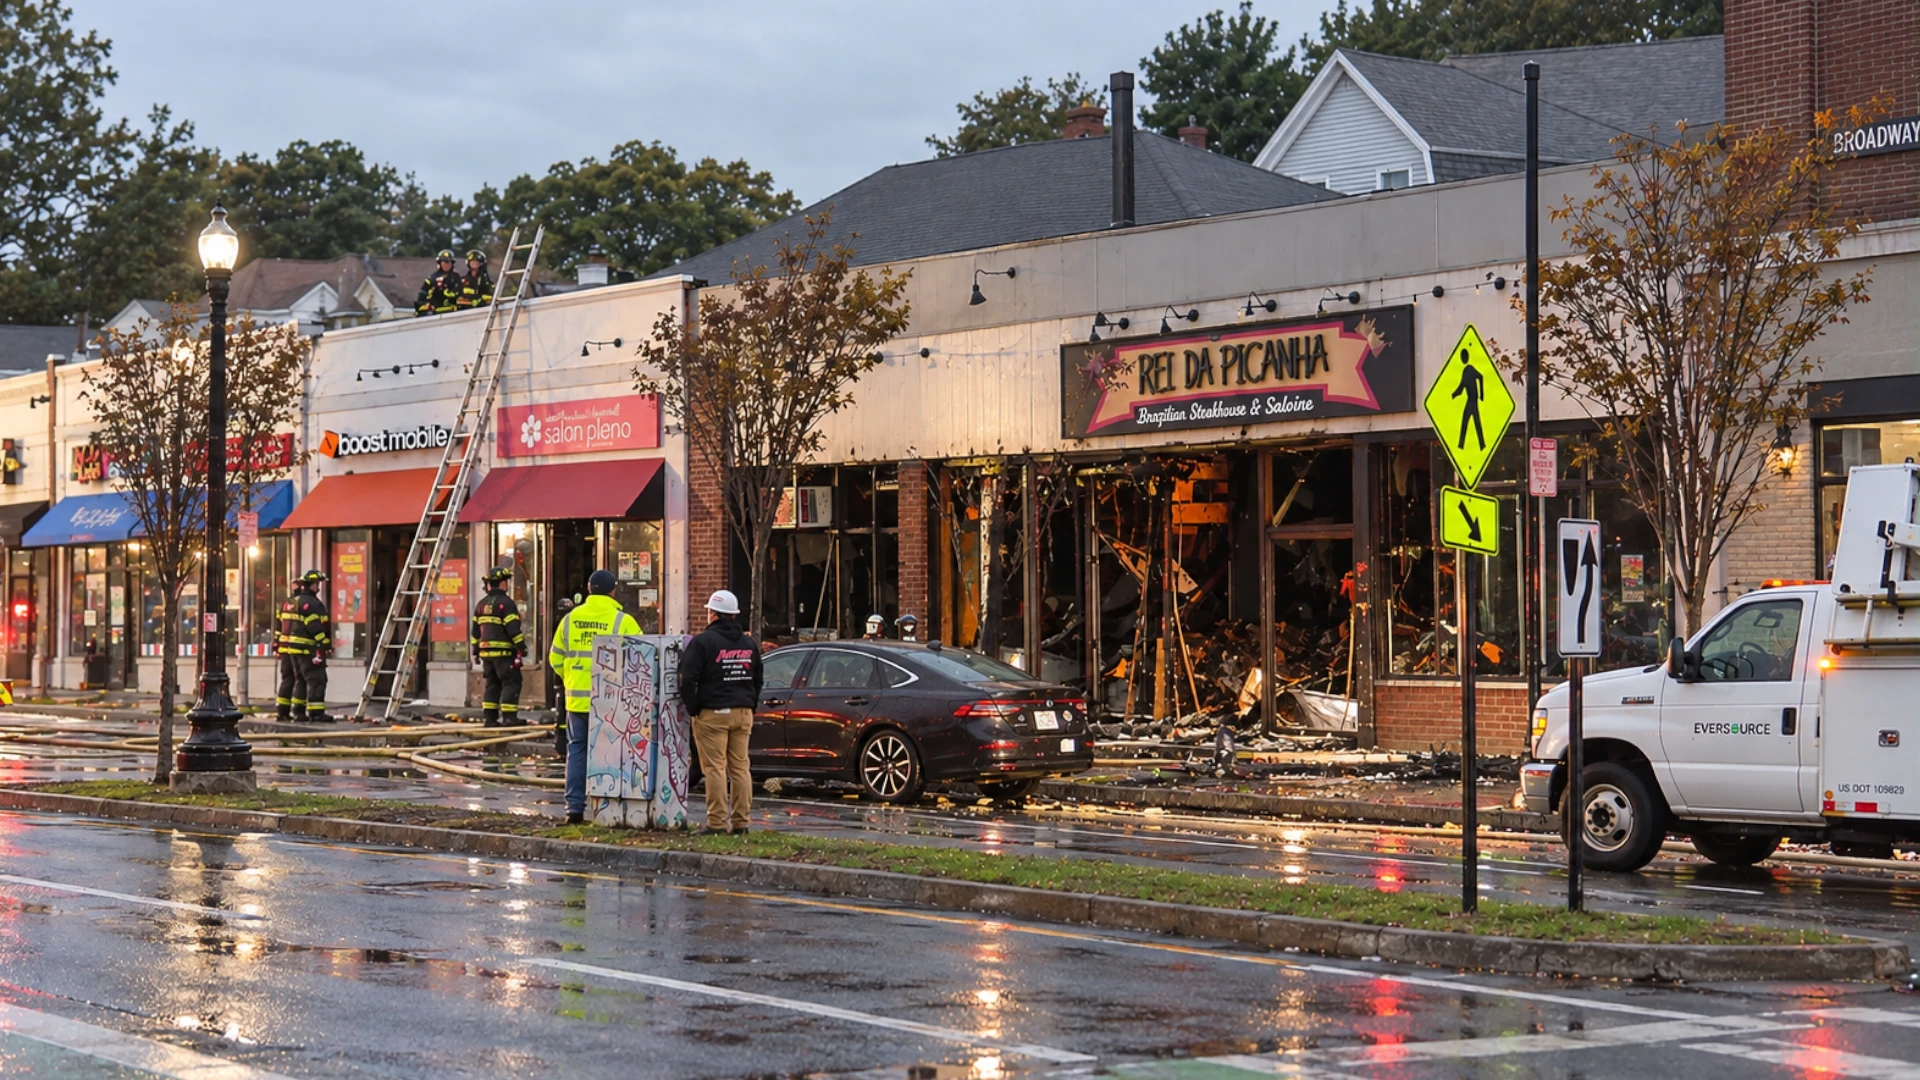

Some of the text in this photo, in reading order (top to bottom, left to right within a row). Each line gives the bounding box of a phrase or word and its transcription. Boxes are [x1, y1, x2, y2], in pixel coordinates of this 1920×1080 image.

[1833, 120, 1920, 153] BROADWAY
[1138, 334, 1329, 395] REI DA PICANHA
[1189, 400, 1247, 421] Steakhouse
[1249, 397, 1262, 416] &
[544, 417, 632, 448] salon pleno
[1694, 722, 1771, 736] EVERSOURCE
[1838, 783, 1850, 793] US
